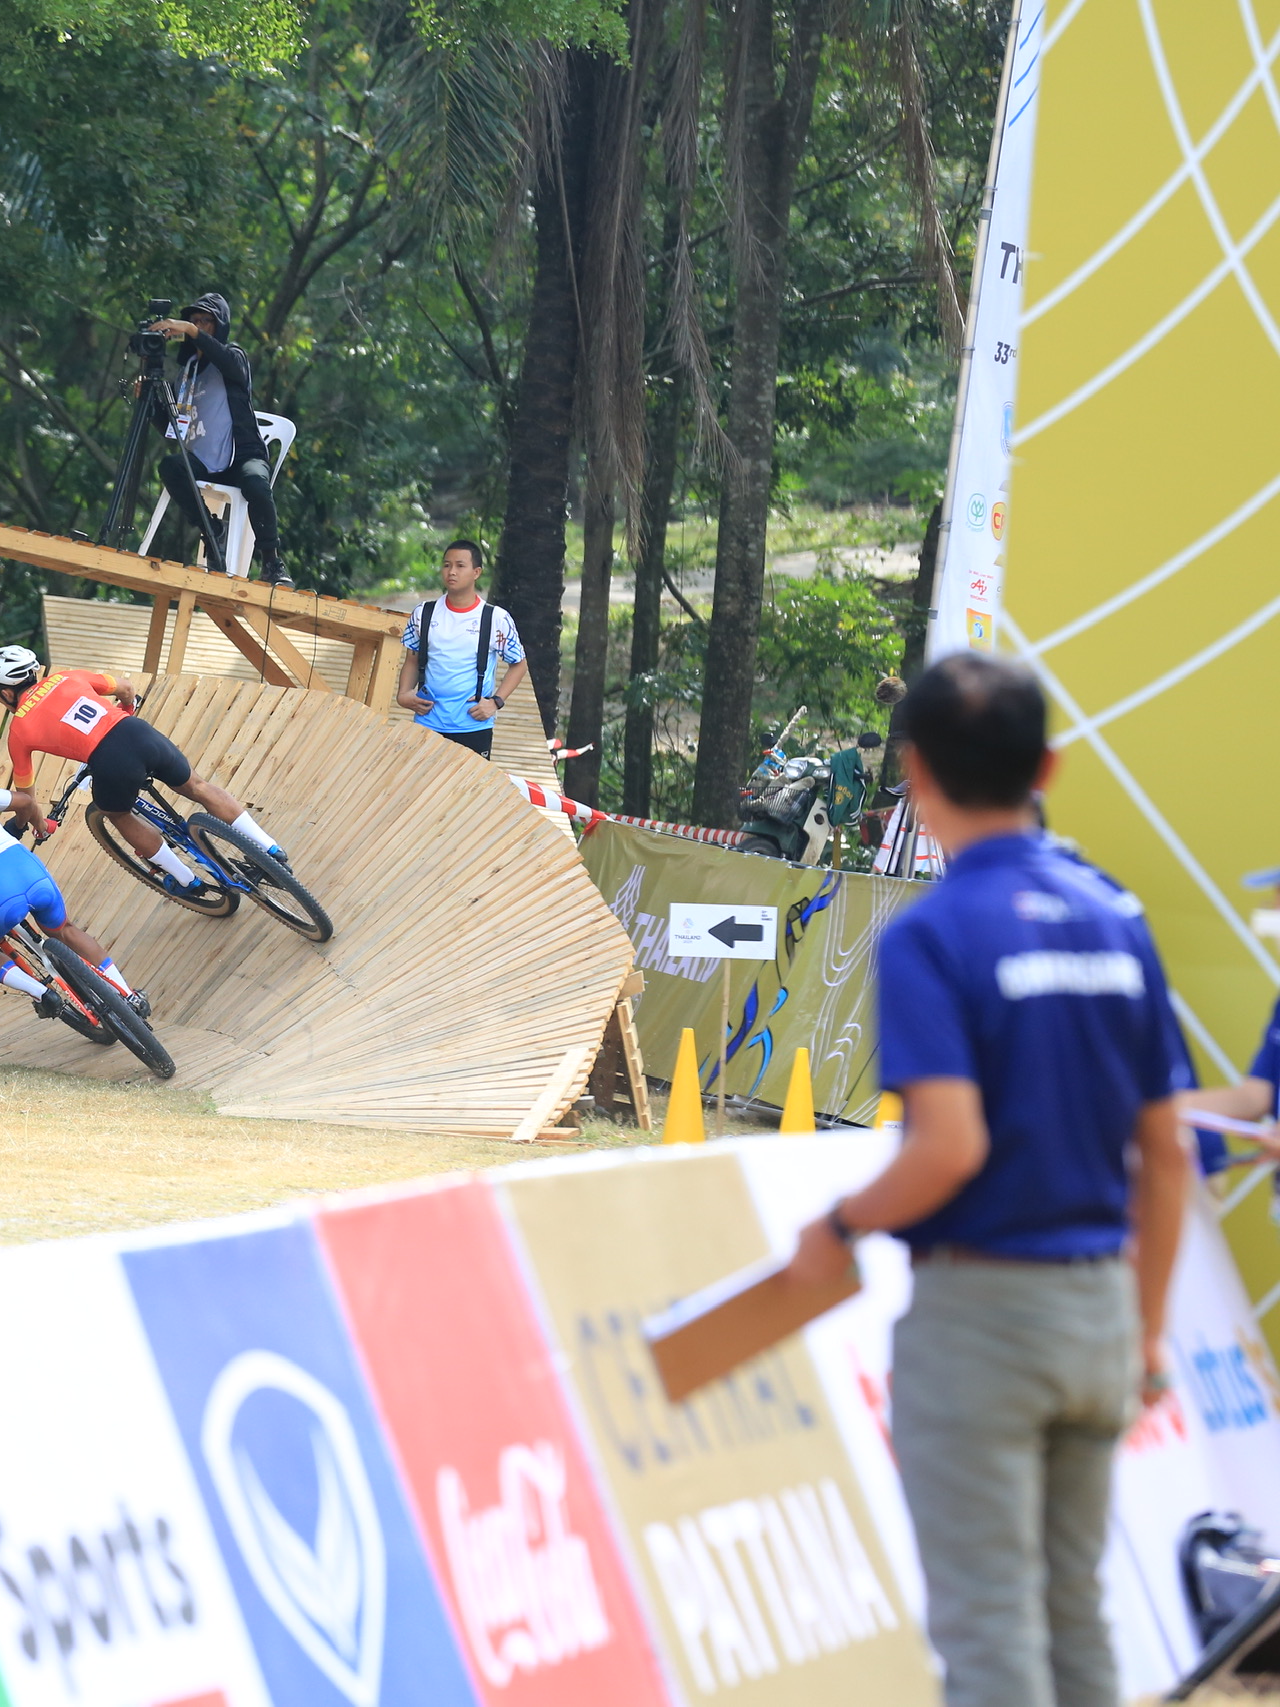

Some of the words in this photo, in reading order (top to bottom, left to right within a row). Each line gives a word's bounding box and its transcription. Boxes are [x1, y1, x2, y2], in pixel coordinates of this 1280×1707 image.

[14, 673, 64, 718] VIETNAM
[73, 704, 98, 724] 10
[576, 1306, 818, 1474] CERAL
[643, 1476, 900, 1695] PATTANA
